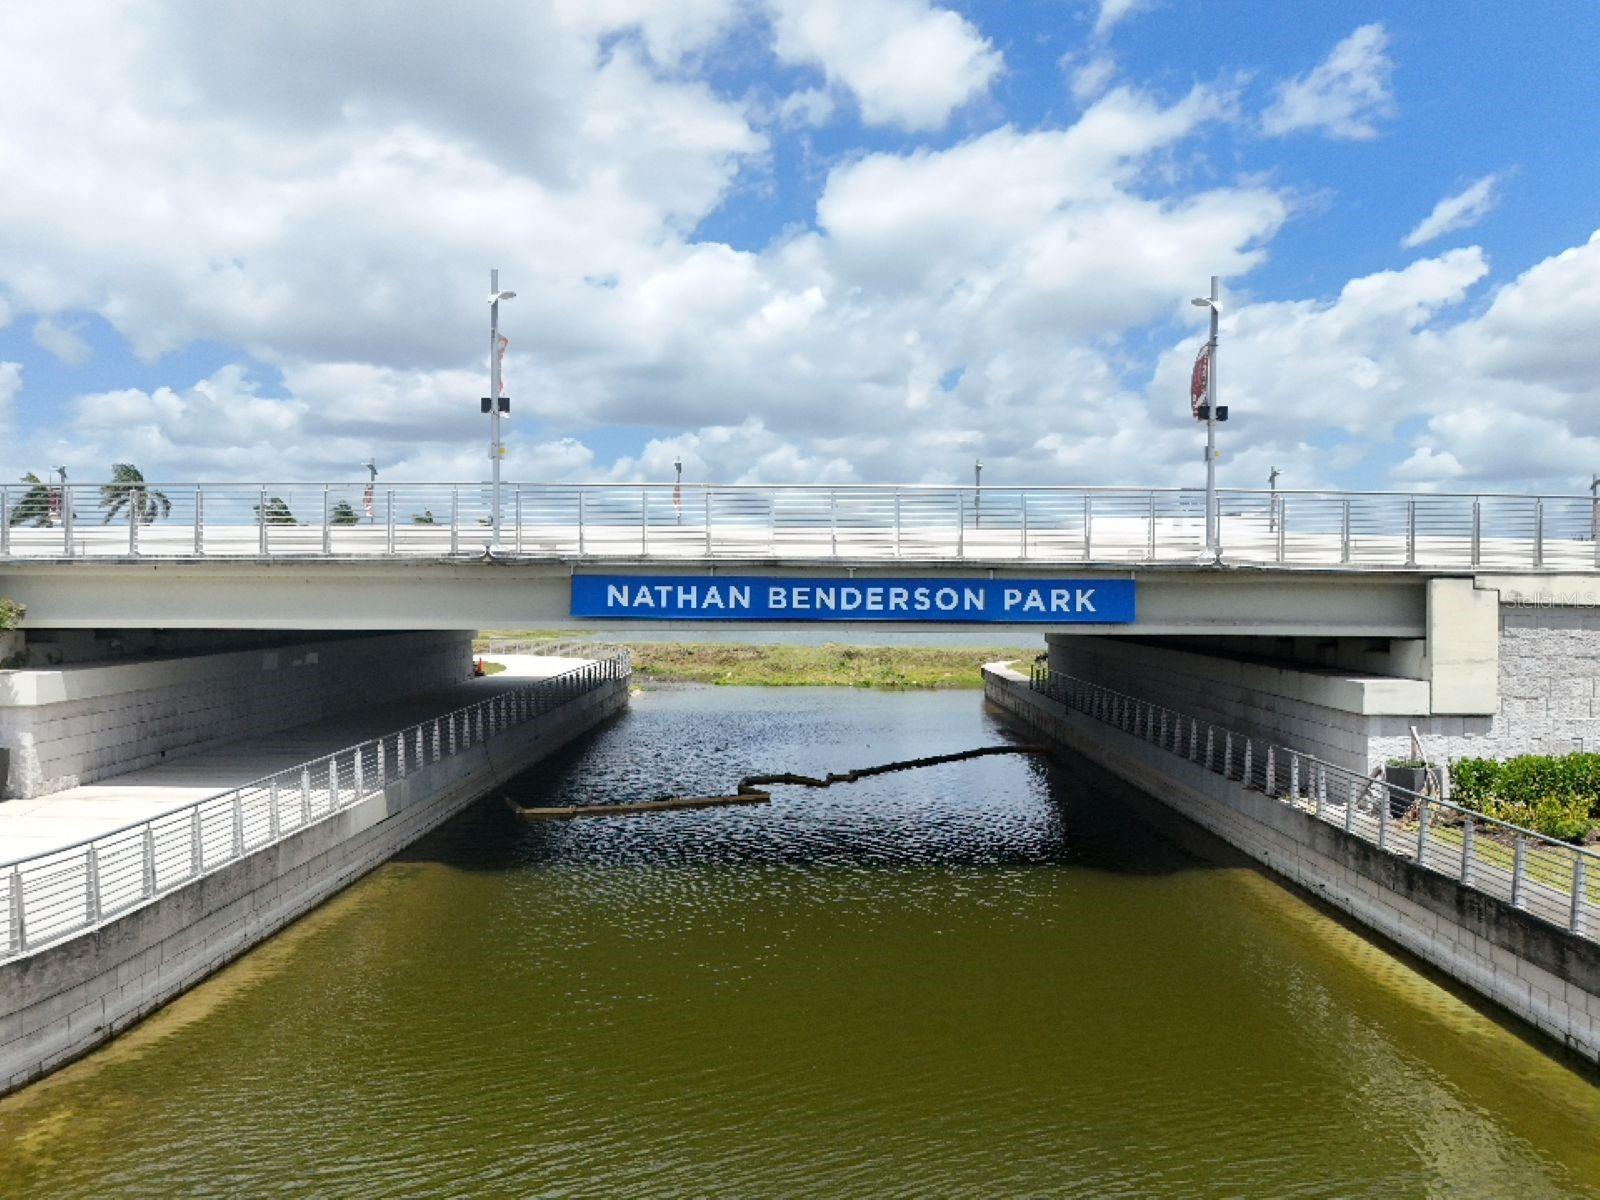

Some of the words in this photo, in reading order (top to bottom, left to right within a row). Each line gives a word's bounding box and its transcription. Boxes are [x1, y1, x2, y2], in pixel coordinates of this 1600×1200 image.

[606, 584, 752, 609] NATHAN
[767, 586, 986, 610] BENDERSON
[1001, 588, 1098, 612] PARK
